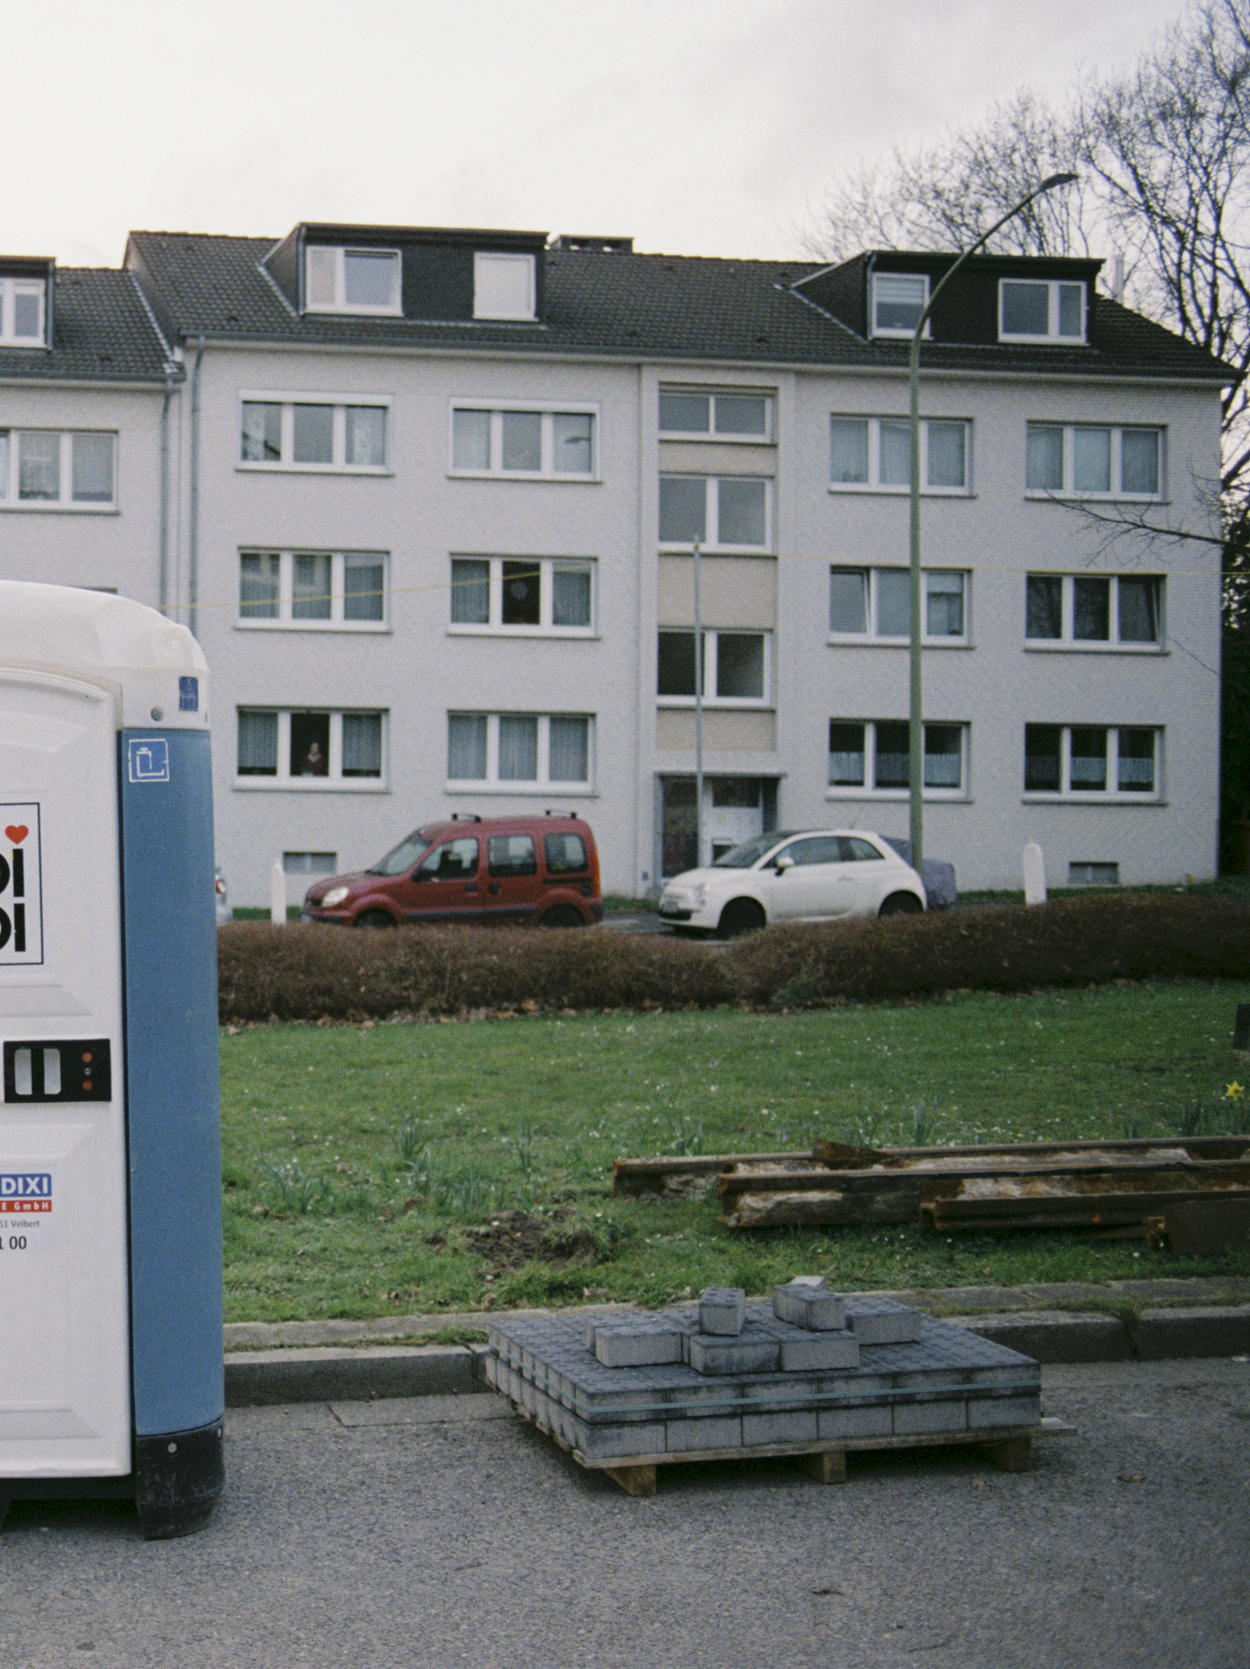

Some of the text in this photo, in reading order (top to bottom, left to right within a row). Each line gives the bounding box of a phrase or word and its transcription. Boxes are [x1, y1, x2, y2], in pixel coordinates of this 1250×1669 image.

[1, 1176, 49, 1195] DIXI
[14, 1201, 49, 1211] GmbH
[10, 1219, 40, 1228] Velbert
[9, 1236, 27, 1250] 00
